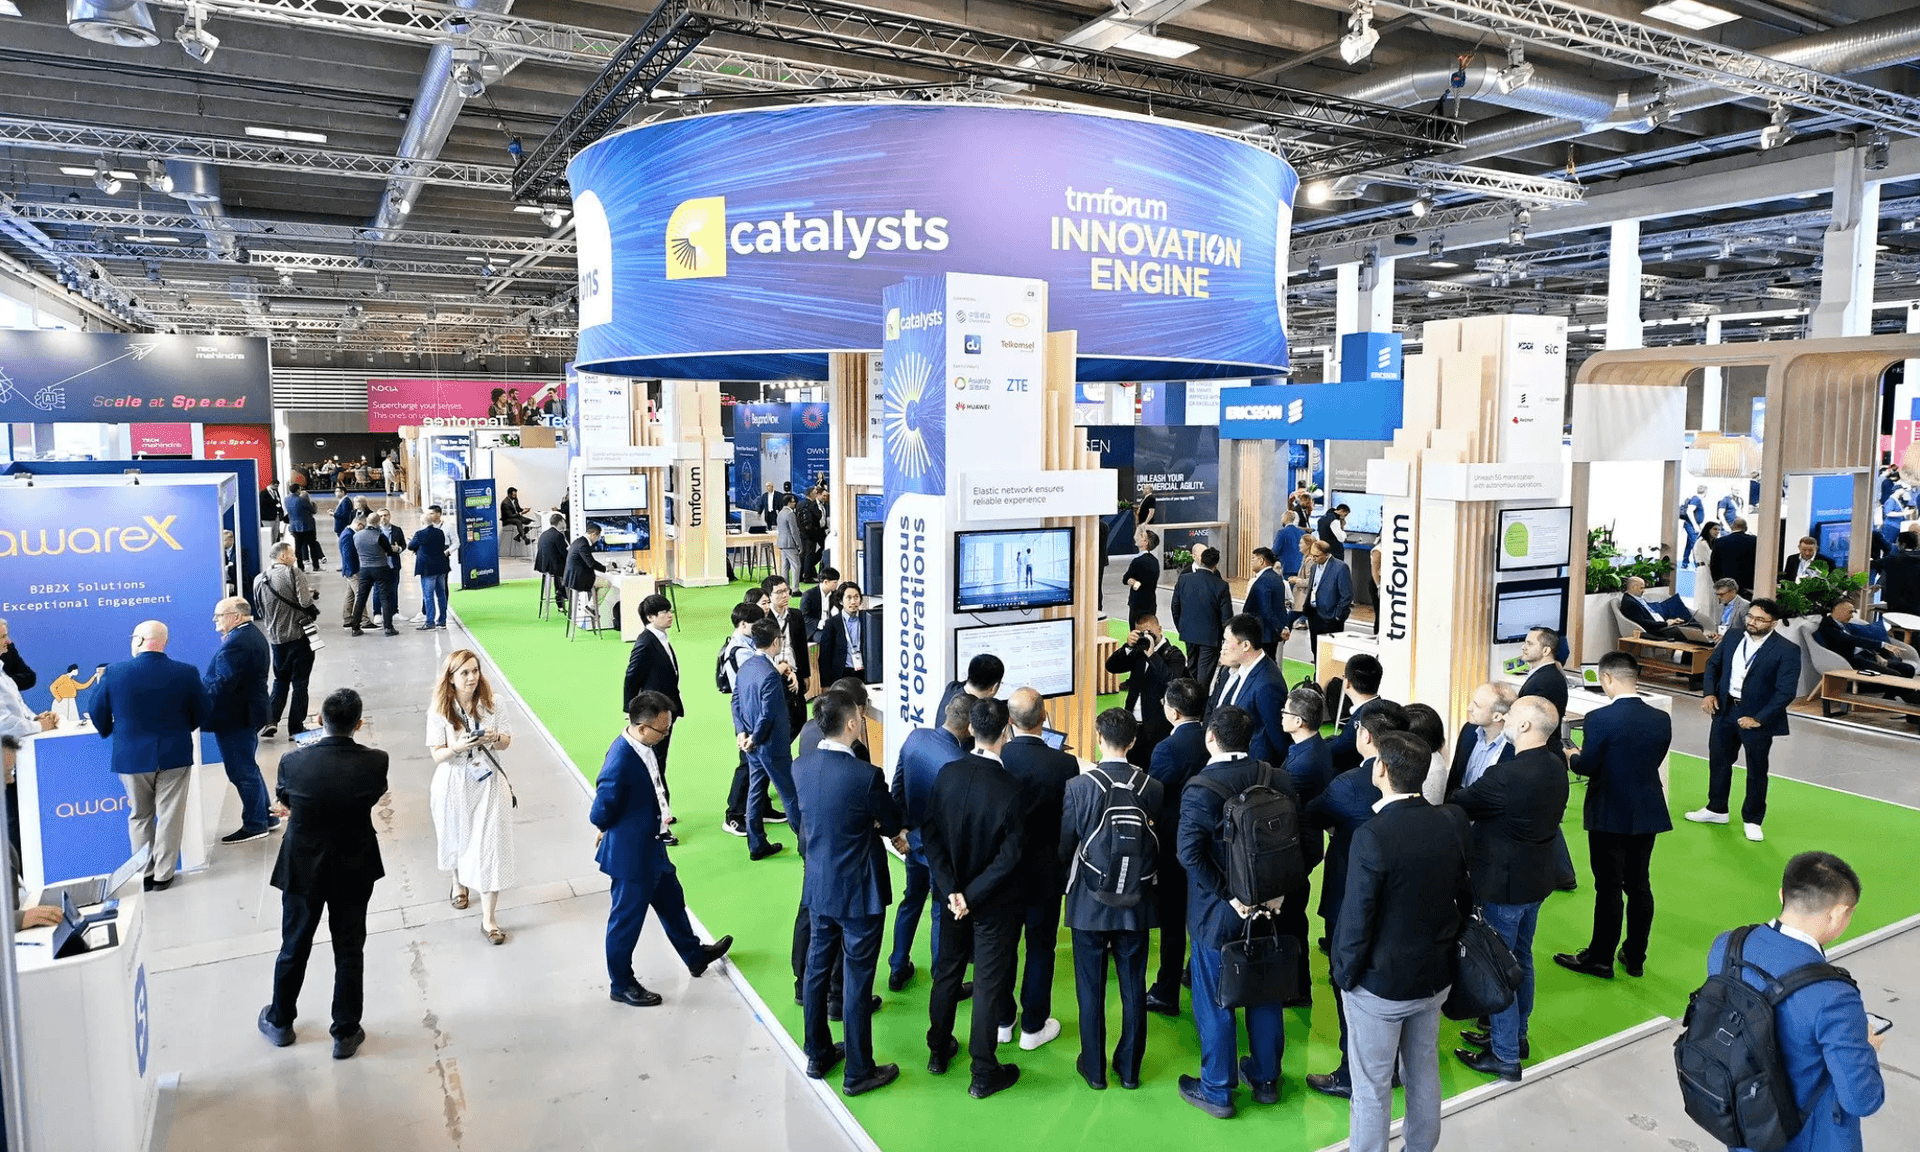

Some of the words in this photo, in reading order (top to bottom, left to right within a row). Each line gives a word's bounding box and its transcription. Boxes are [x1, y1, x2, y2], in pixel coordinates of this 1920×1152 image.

[1065, 186, 1168, 221] tmforum
[730, 208, 949, 260] catalysts
[1051, 216, 1241, 269] INNOVATION
[1091, 257, 1210, 299] ENGINE
[900, 309, 943, 331] catalysts
[966, 339, 980, 350] du
[1001, 340, 1034, 350] Telkomsel
[1544, 344, 1559, 354] stc
[196, 351, 245, 360] mahindra
[1006, 378, 1028, 392] ZTE
[44, 394, 57, 403] AI
[92, 394, 142, 408] Scale
[149, 397, 165, 407] at
[171, 394, 247, 410] Speed
[372, 401, 418, 411] Supercharge
[1225, 405, 1284, 420] ERICSSON
[1137, 474, 1166, 482] UNLEASH
[1168, 473, 1184, 482] YOUR
[688, 467, 702, 527] tmforum
[973, 486, 1000, 495] Elastic
[1001, 486, 1033, 494] network
[1035, 485, 1064, 493] ensures
[973, 497, 1002, 505] reliable
[1004, 496, 1046, 504] experience
[1386, 514, 1409, 641] tmforum
[30, 583, 70, 594] B2B2X
[78, 581, 146, 592] Solutions
[3, 598, 89, 612] Exceptional
[98, 595, 172, 609] Engagement
[910, 518, 927, 695] operations
[899, 515, 909, 723] autonomous
